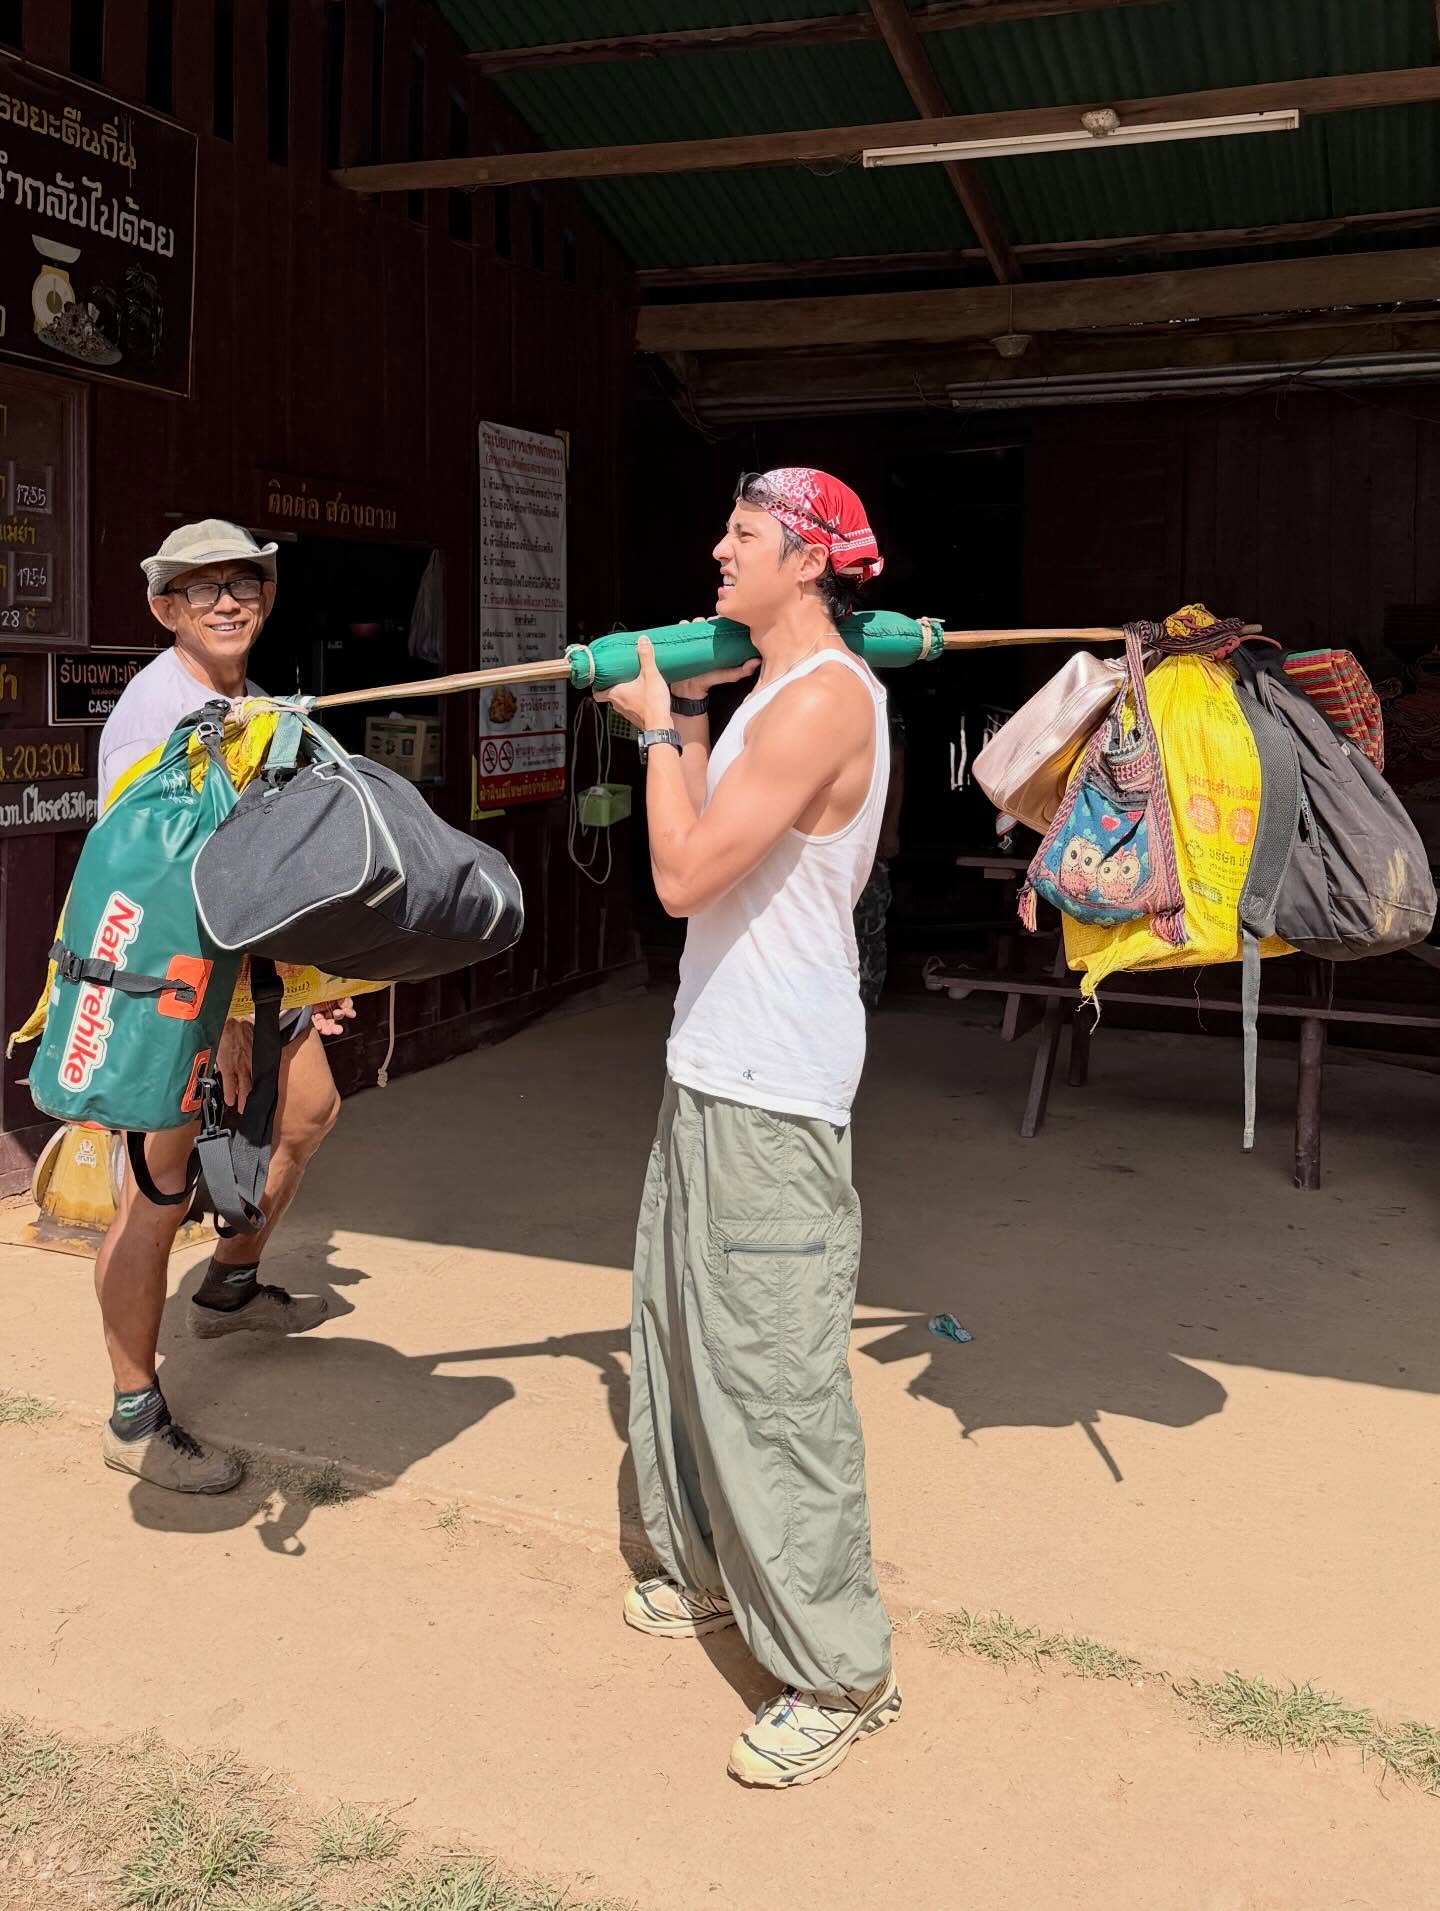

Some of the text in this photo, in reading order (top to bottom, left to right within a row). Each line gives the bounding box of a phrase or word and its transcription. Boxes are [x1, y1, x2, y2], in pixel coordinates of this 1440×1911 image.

[268, 479, 319, 520] ติดต่อ
[60, 658, 142, 684] รับเฉพาะเงิ
[88, 700, 114, 713] CASH
[63, 899, 136, 1084] Natrehike
